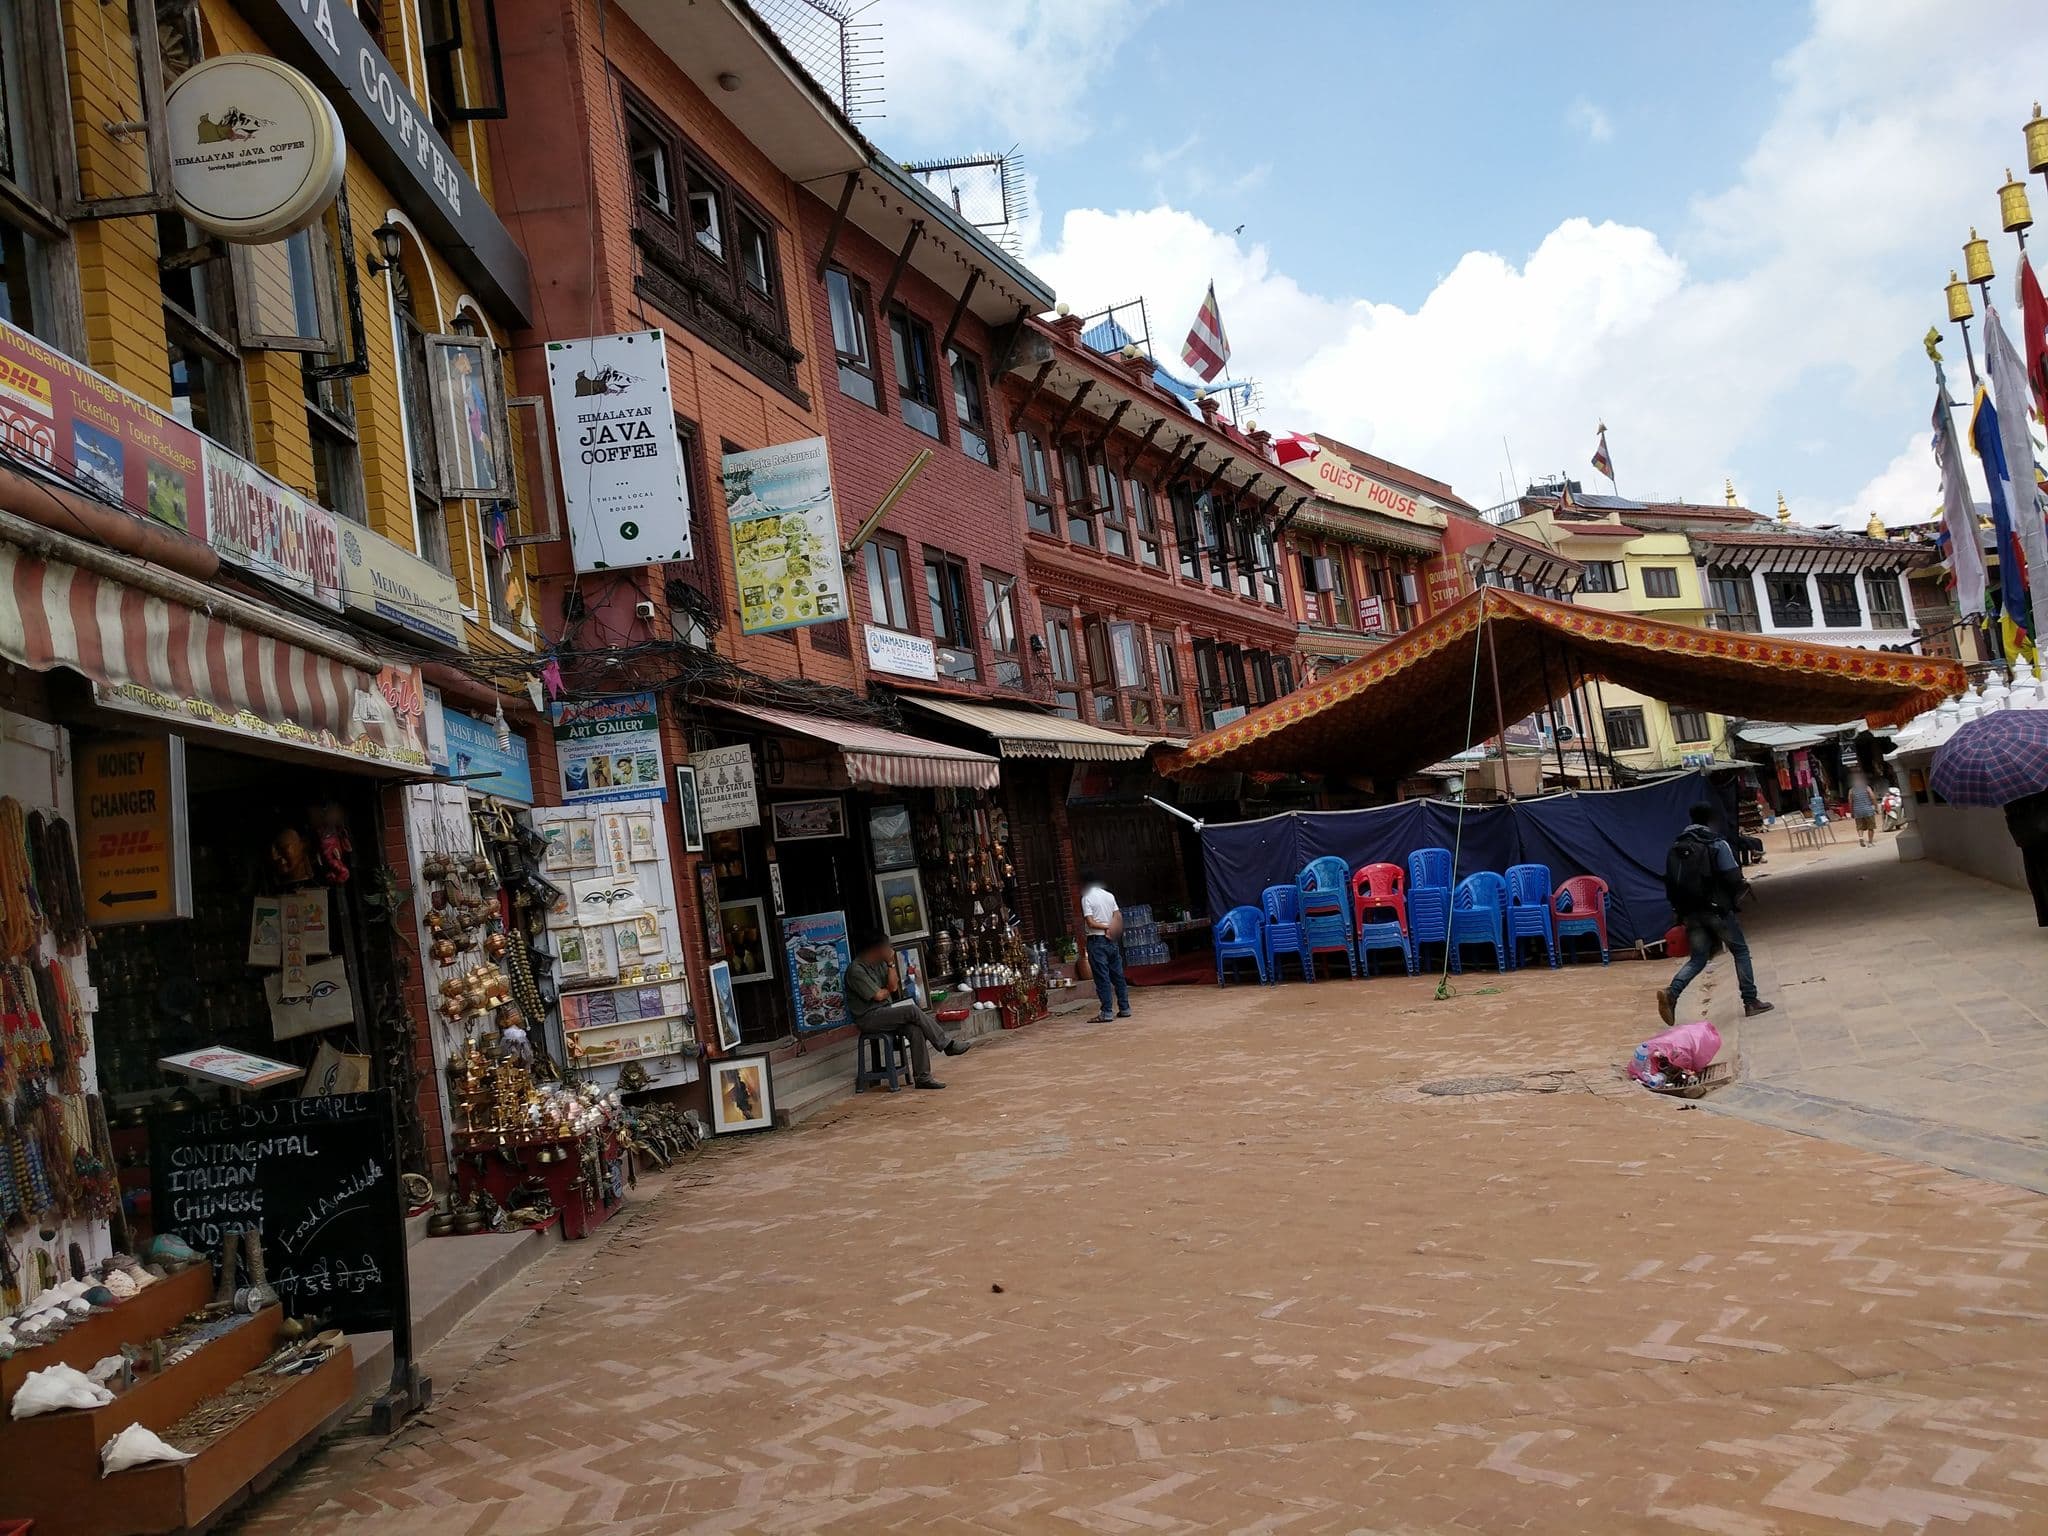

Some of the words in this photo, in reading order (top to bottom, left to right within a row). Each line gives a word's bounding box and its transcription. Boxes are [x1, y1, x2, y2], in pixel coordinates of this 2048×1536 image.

[359, 47, 462, 217] COFFEE
[174, 151, 235, 166] HIMALAYAN
[239, 147, 265, 158] JAVA
[269, 140, 305, 153] COFFEE
[74, 366, 119, 404] Village
[577, 406, 653, 424] HIMALAYAN
[70, 388, 120, 433] Ticketing
[127, 420, 151, 446] Tour
[151, 434, 198, 472] Packages
[579, 420, 656, 447] JAVA
[581, 442, 658, 465] COFFEE
[728, 463, 748, 474] Blue
[750, 459, 772, 471] Lake
[772, 447, 822, 466] Restaurant
[597, 495, 624, 503] THINK
[627, 491, 654, 500] LOCAL
[1319, 462, 1365, 494] GUEST
[1368, 482, 1418, 519] HOUSE
[609, 503, 645, 513] BOUDHA
[210, 463, 276, 554] MONEY
[269, 498, 338, 590] EXCHANGE
[1432, 586, 1460, 603] STUPA
[879, 633, 911, 650] NAMASTE
[911, 641, 931, 655] BEADS
[444, 718, 474, 744] NRISE
[569, 725, 591, 738] ART
[595, 719, 645, 733] GALLERY
[96, 751, 145, 778] MONEY
[709, 750, 749, 768] ARCADE
[700, 784, 726, 797] UALITY
[726, 780, 753, 792] STATUE
[732, 790, 749, 800] HERE
[90, 789, 157, 819] CHANGER
[96, 831, 158, 859] DHL
[239, 1103, 279, 1128] DU
[170, 1135, 319, 1167] CONTINENTAL
[168, 1162, 257, 1193] ITALIAN
[172, 1188, 264, 1222] CHINESE
[277, 1206, 321, 1254] Food
